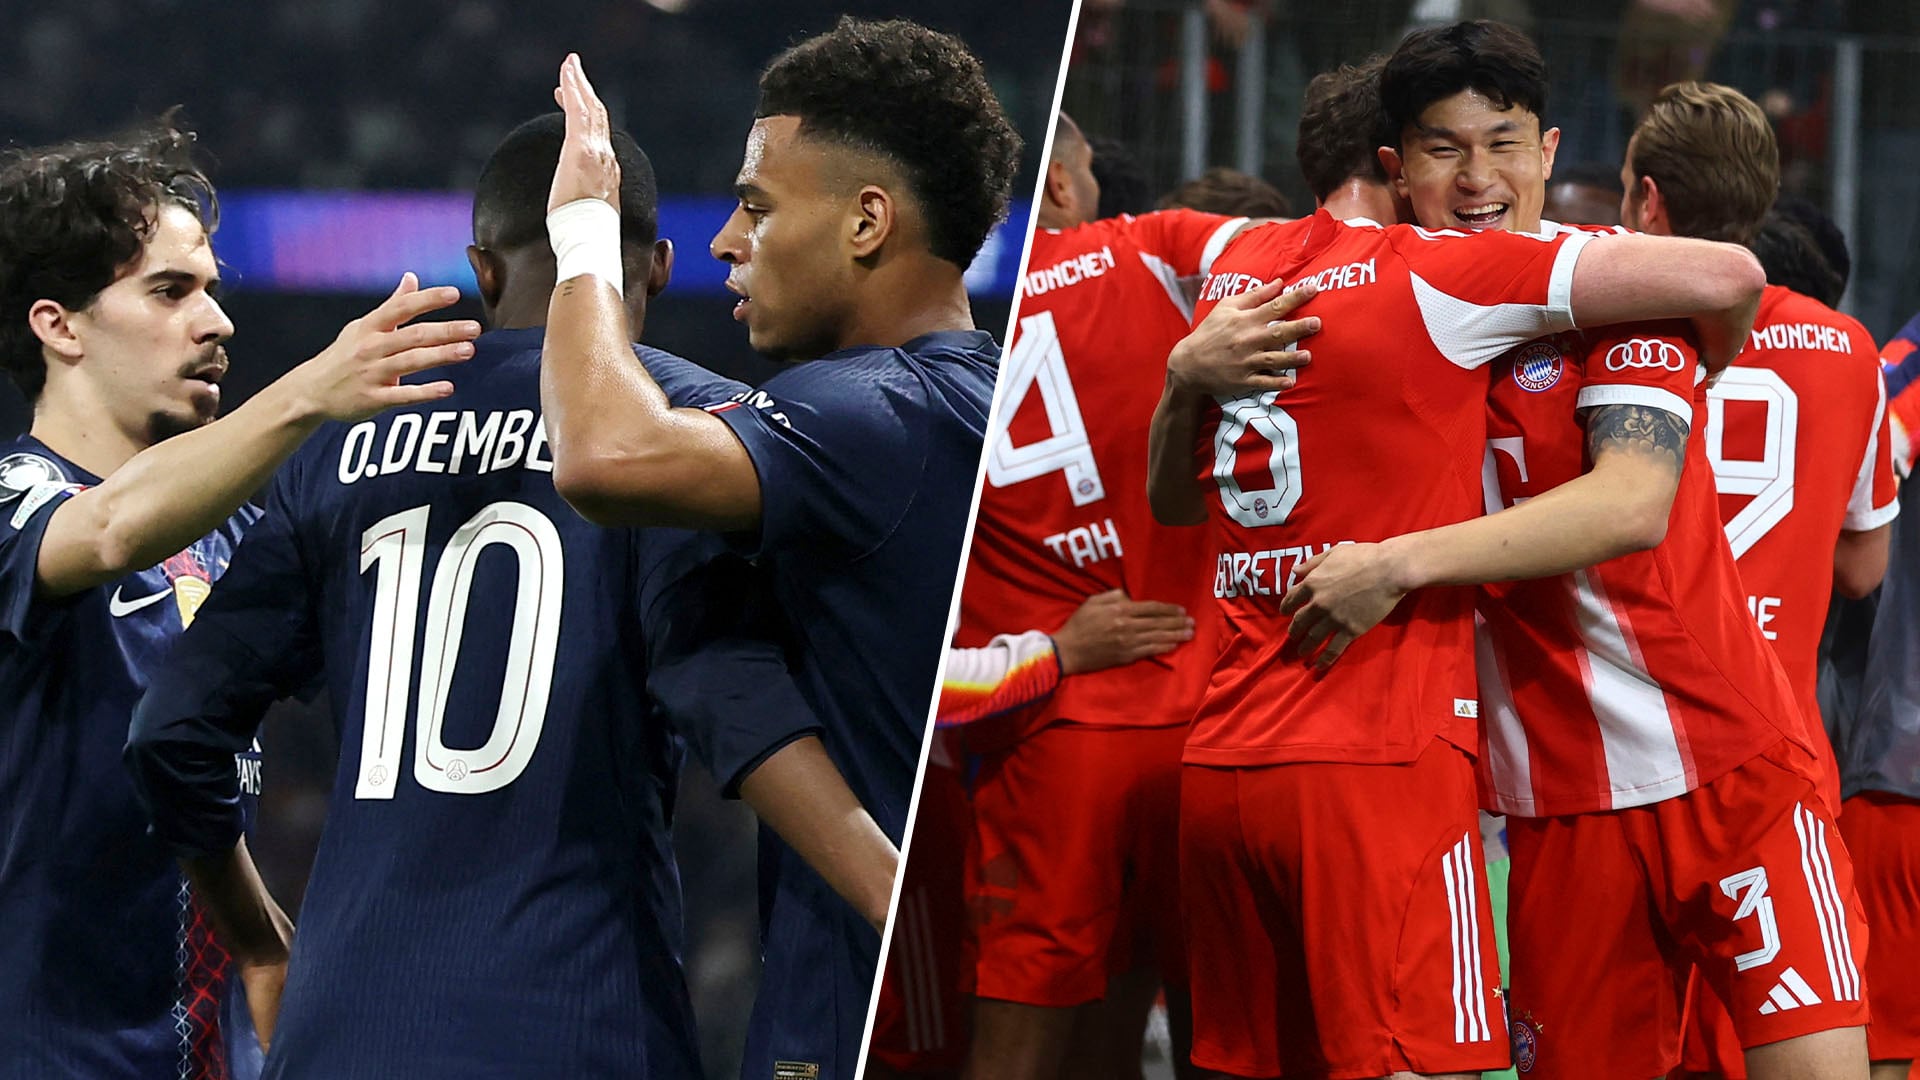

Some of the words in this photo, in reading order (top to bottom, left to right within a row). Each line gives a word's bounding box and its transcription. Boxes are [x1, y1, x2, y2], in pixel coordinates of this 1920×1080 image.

[338, 409, 553, 484] O.DEMBE
[986, 310, 1105, 507] 4
[1704, 366, 1798, 561] 9
[1043, 518, 1123, 568] TAH
[354, 500, 564, 800] 10
[1719, 866, 1781, 972] 3
